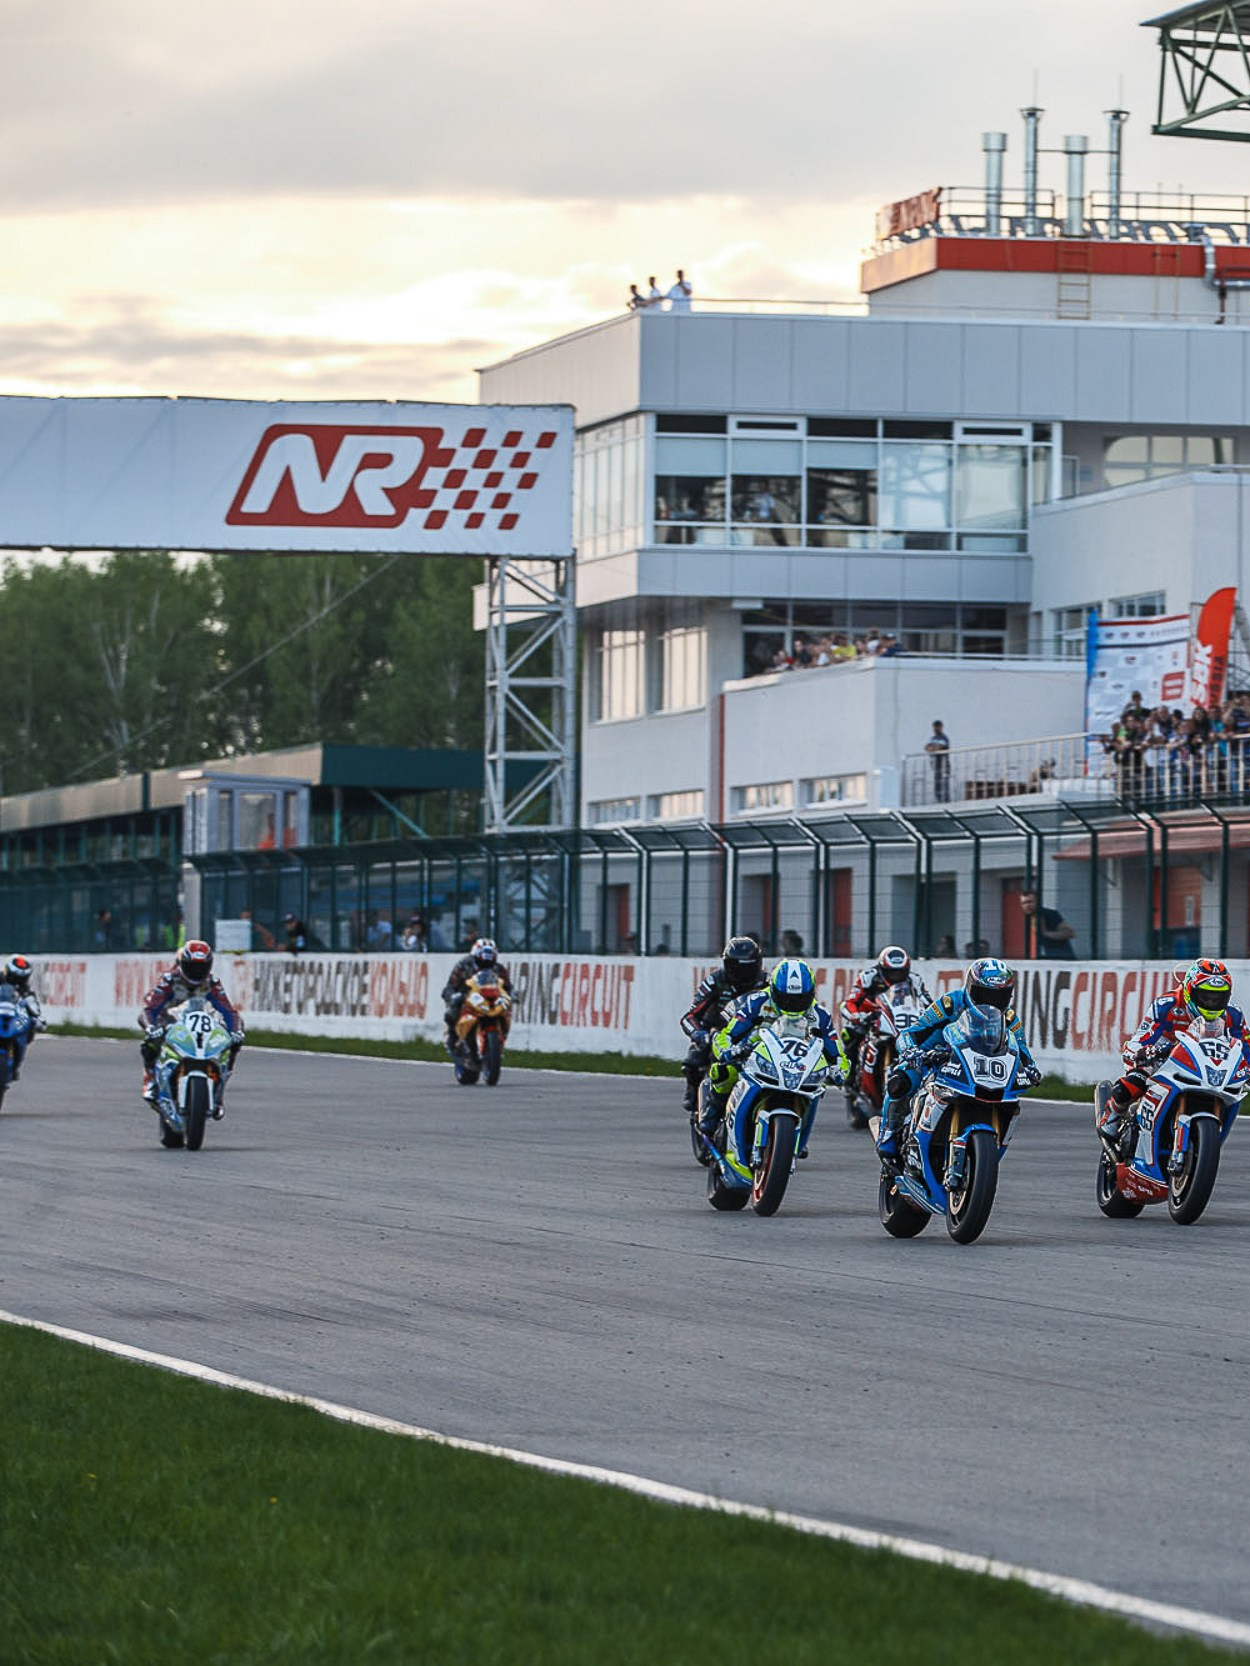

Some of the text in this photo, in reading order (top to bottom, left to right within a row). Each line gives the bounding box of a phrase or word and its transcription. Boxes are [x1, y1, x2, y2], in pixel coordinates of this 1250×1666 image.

[241, 433, 426, 517] NR
[189, 1014, 212, 1033] 78
[780, 1040, 810, 1058] 76
[1199, 1041, 1231, 1061] 65
[973, 1055, 1007, 1081] 10
